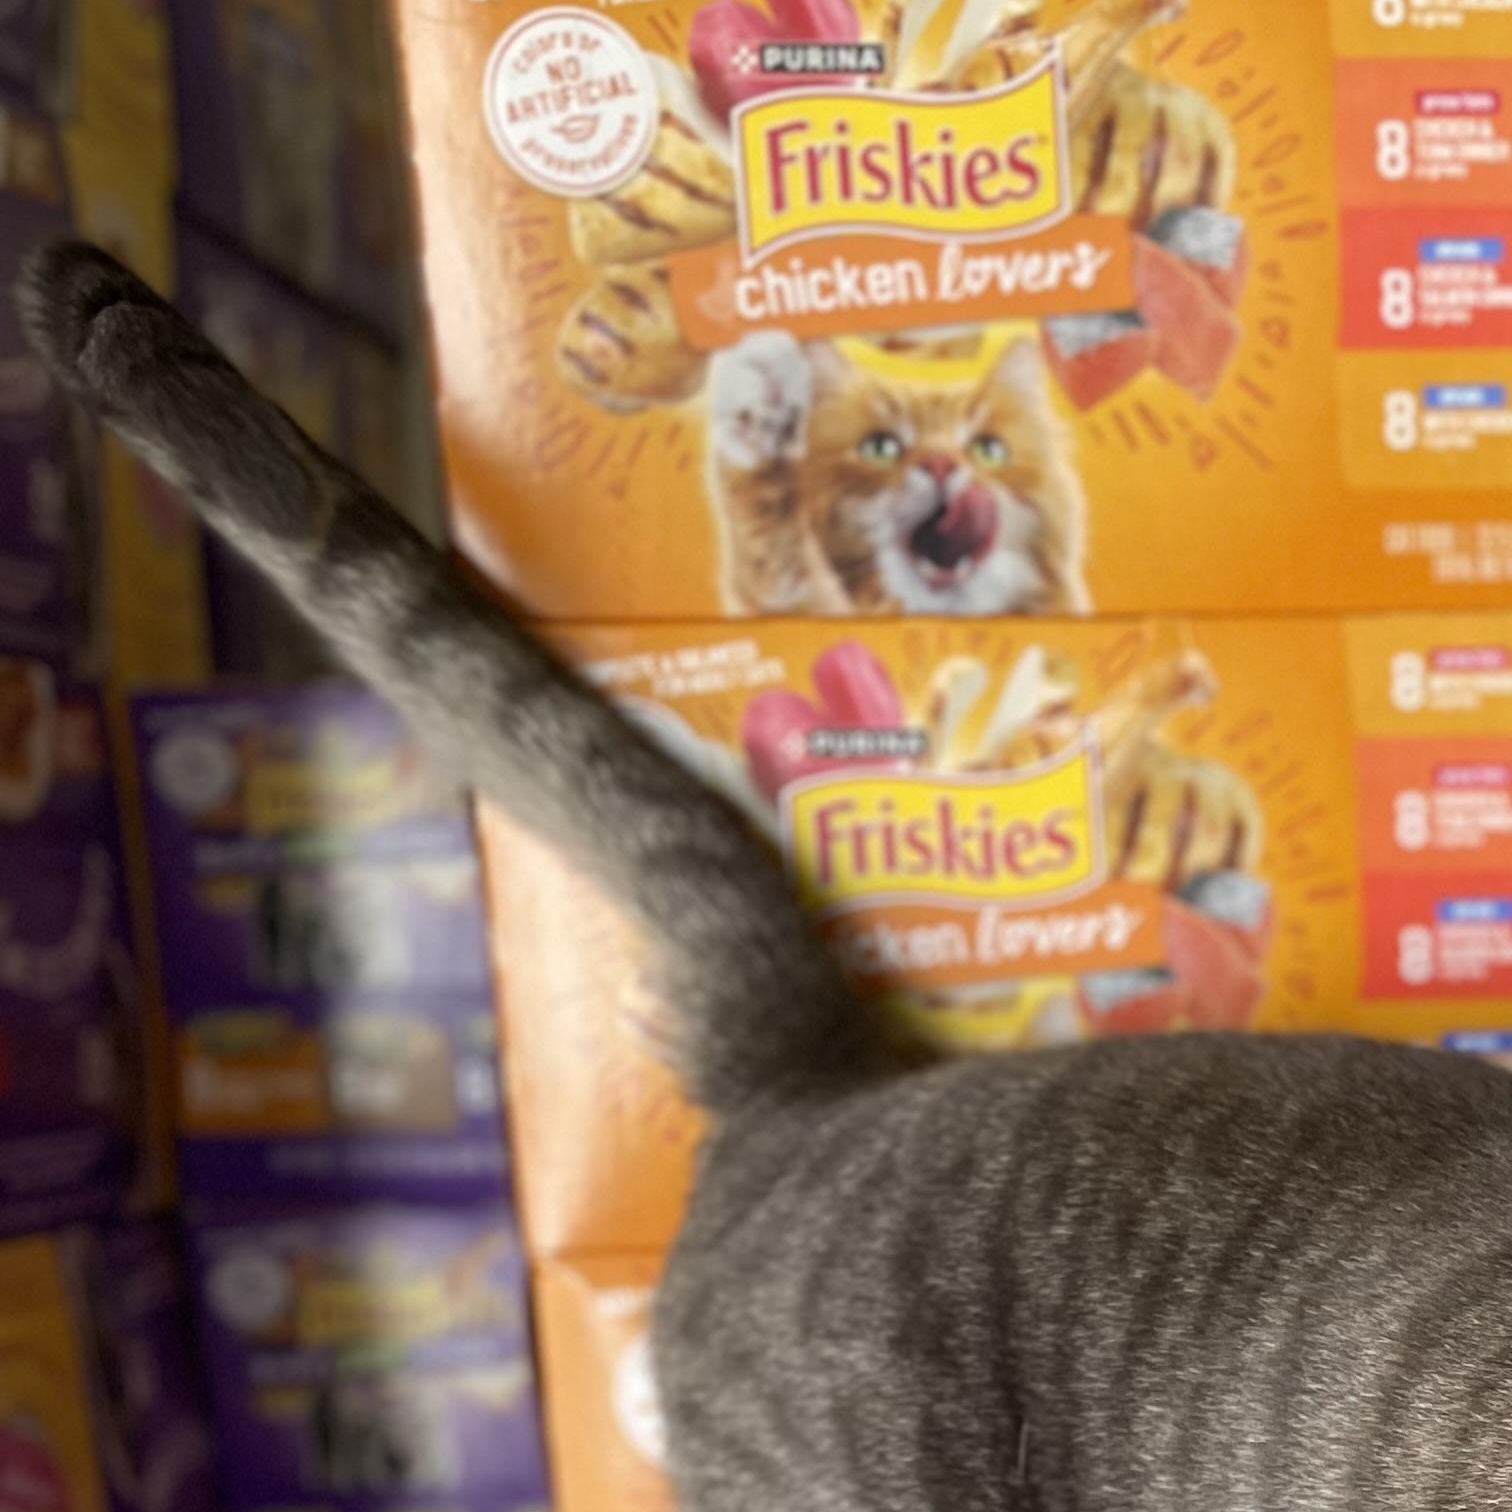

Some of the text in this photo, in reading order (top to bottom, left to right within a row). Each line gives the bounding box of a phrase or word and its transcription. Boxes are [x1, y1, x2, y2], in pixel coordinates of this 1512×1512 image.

[545, 56, 582, 84] NO
[761, 46, 882, 71] PURINA
[765, 119, 1040, 215] Friskies
[1376, 118, 1411, 181] 8
[735, 258, 928, 319] chicken
[1379, 266, 1414, 330] 8
[1382, 388, 1417, 452] 8
[814, 797, 1076, 891] Friskies
